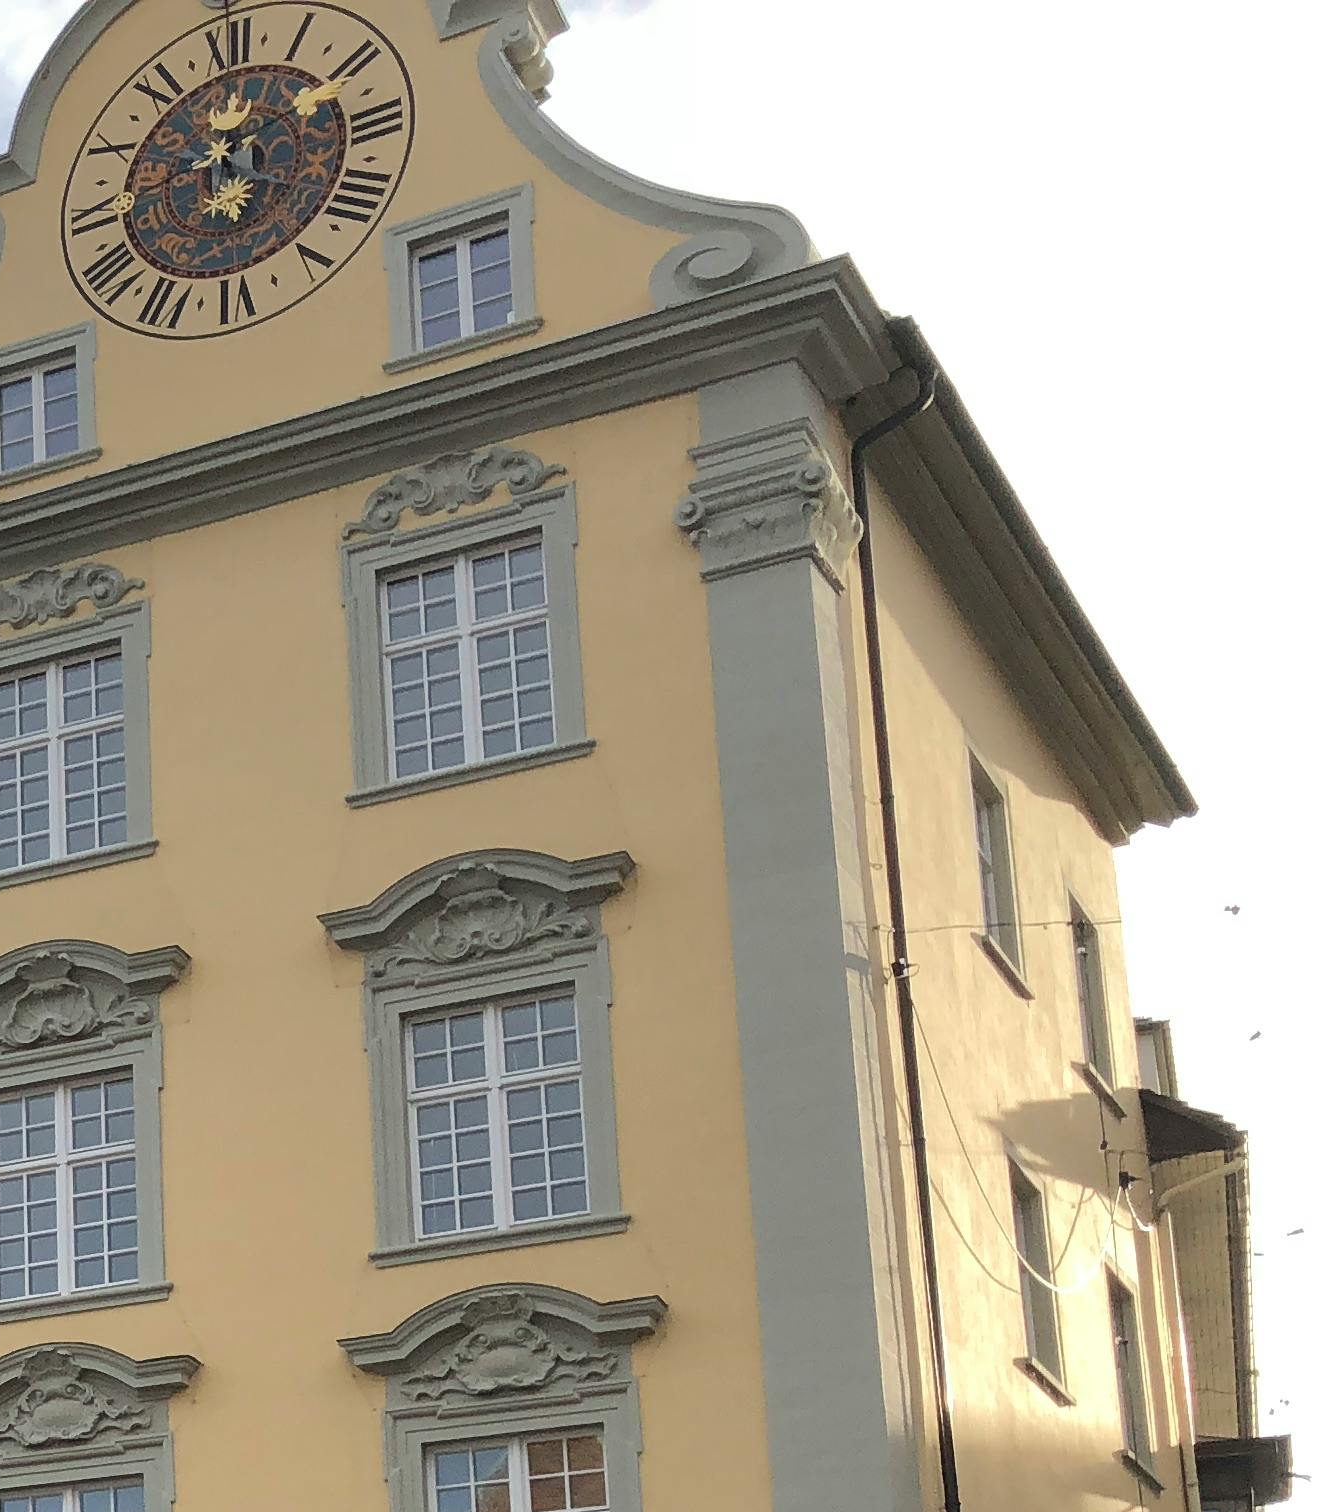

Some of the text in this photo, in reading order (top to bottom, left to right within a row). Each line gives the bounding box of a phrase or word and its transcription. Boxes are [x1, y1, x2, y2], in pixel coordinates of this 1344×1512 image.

[204, 16, 252, 77] XII
[327, 38, 382, 82] II
[132, 62, 185, 116] XI
[349, 97, 403, 147] III
[86, 132, 139, 164] X
[322, 168, 393, 224] IIII
[295, 242, 336, 284] V
[218, 274, 257, 326] VI
